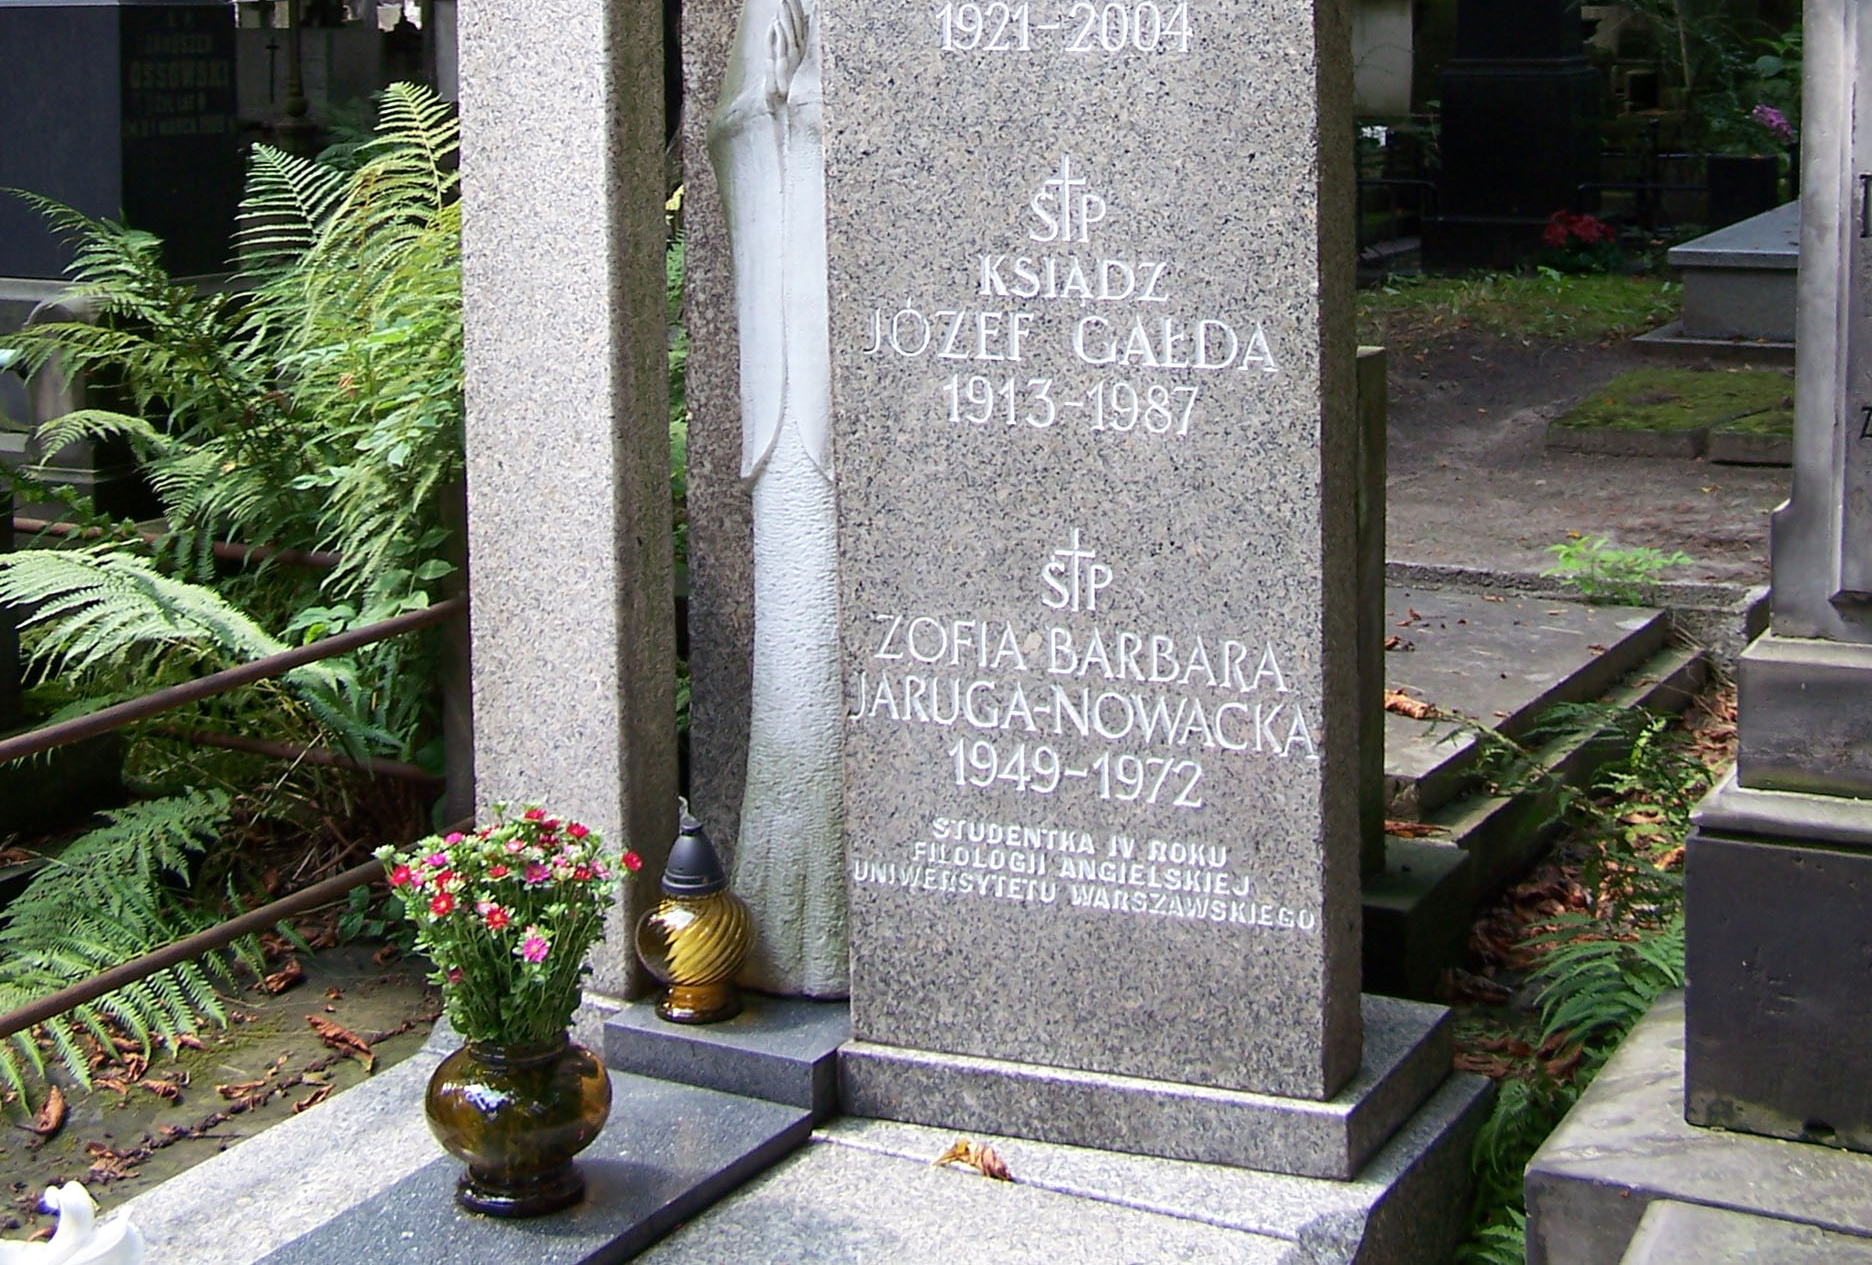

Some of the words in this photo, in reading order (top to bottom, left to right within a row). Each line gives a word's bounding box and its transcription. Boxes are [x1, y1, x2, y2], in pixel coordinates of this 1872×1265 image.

[936, 1, 1194, 53] 1921-2004
[977, 254, 1170, 308] KSIĄDZ
[864, 297, 1035, 362] JÓZEF
[1073, 315, 1279, 372] GAŁDA
[943, 375, 1200, 435] 1913-1987
[874, 614, 1027, 672] ZOFIA
[1047, 626, 1289, 693] BARBARA
[848, 671, 1320, 760] JARUGA-NOWACKA
[948, 737, 1203, 809] 1949-1972
[912, 841, 1046, 876] FILOLOGII
[1059, 856, 1250, 896] ANGIELSKIEJ
[932, 818, 1095, 854] STUDENTKA
[1108, 835, 1136, 859] IV
[1148, 840, 1228, 868] ROKU
[854, 860, 1057, 903] UNIWERSYTETU
[1071, 885, 1316, 930] WARSZAWSKIEGO
